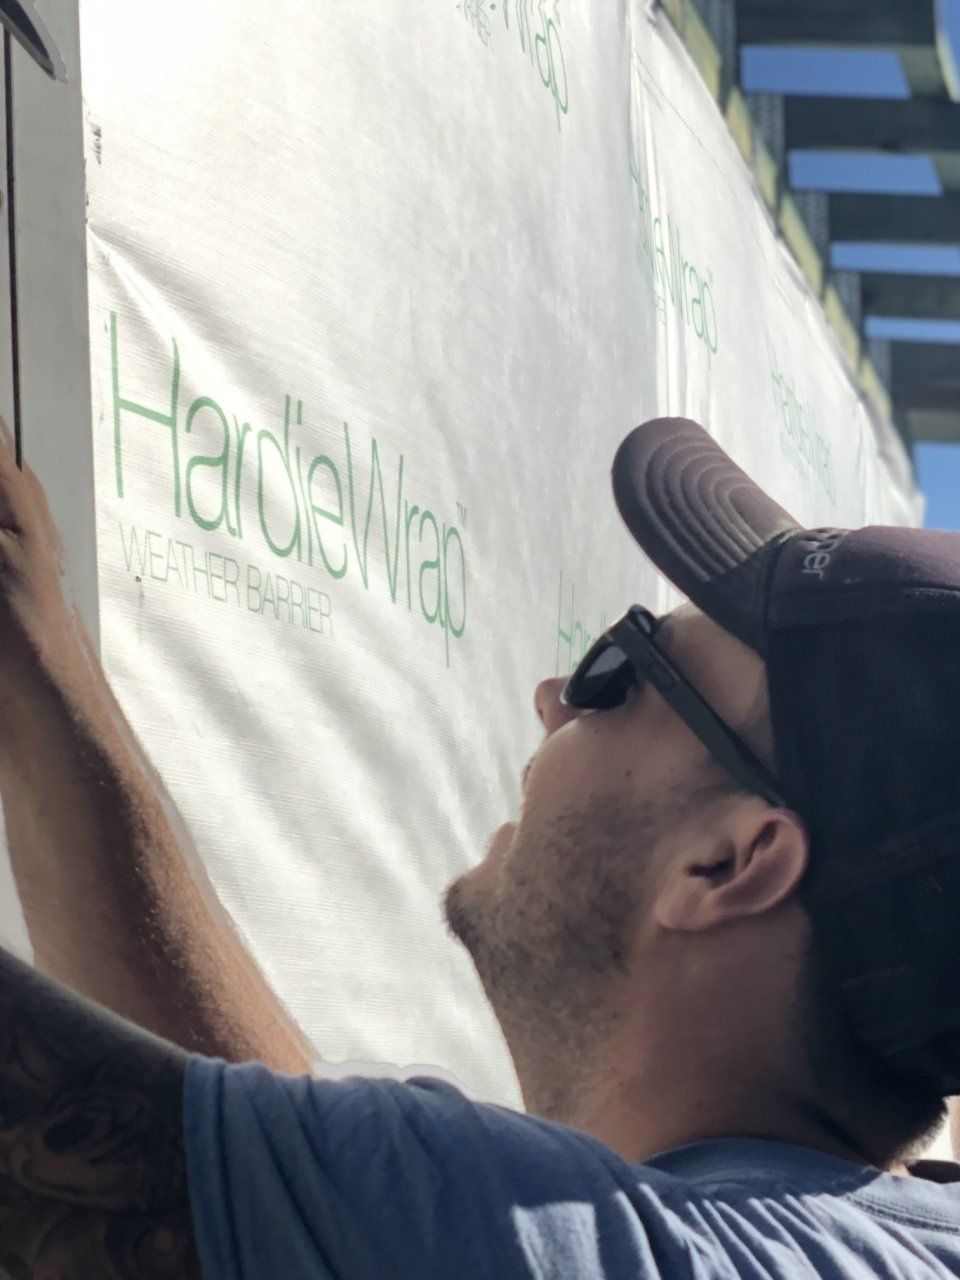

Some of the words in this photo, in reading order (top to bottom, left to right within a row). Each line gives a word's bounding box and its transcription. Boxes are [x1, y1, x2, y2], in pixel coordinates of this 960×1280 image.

[110, 310, 467, 668] HardieWrap
[118, 521, 240, 607] WEATHER
[246, 564, 334, 637] BARRIER
